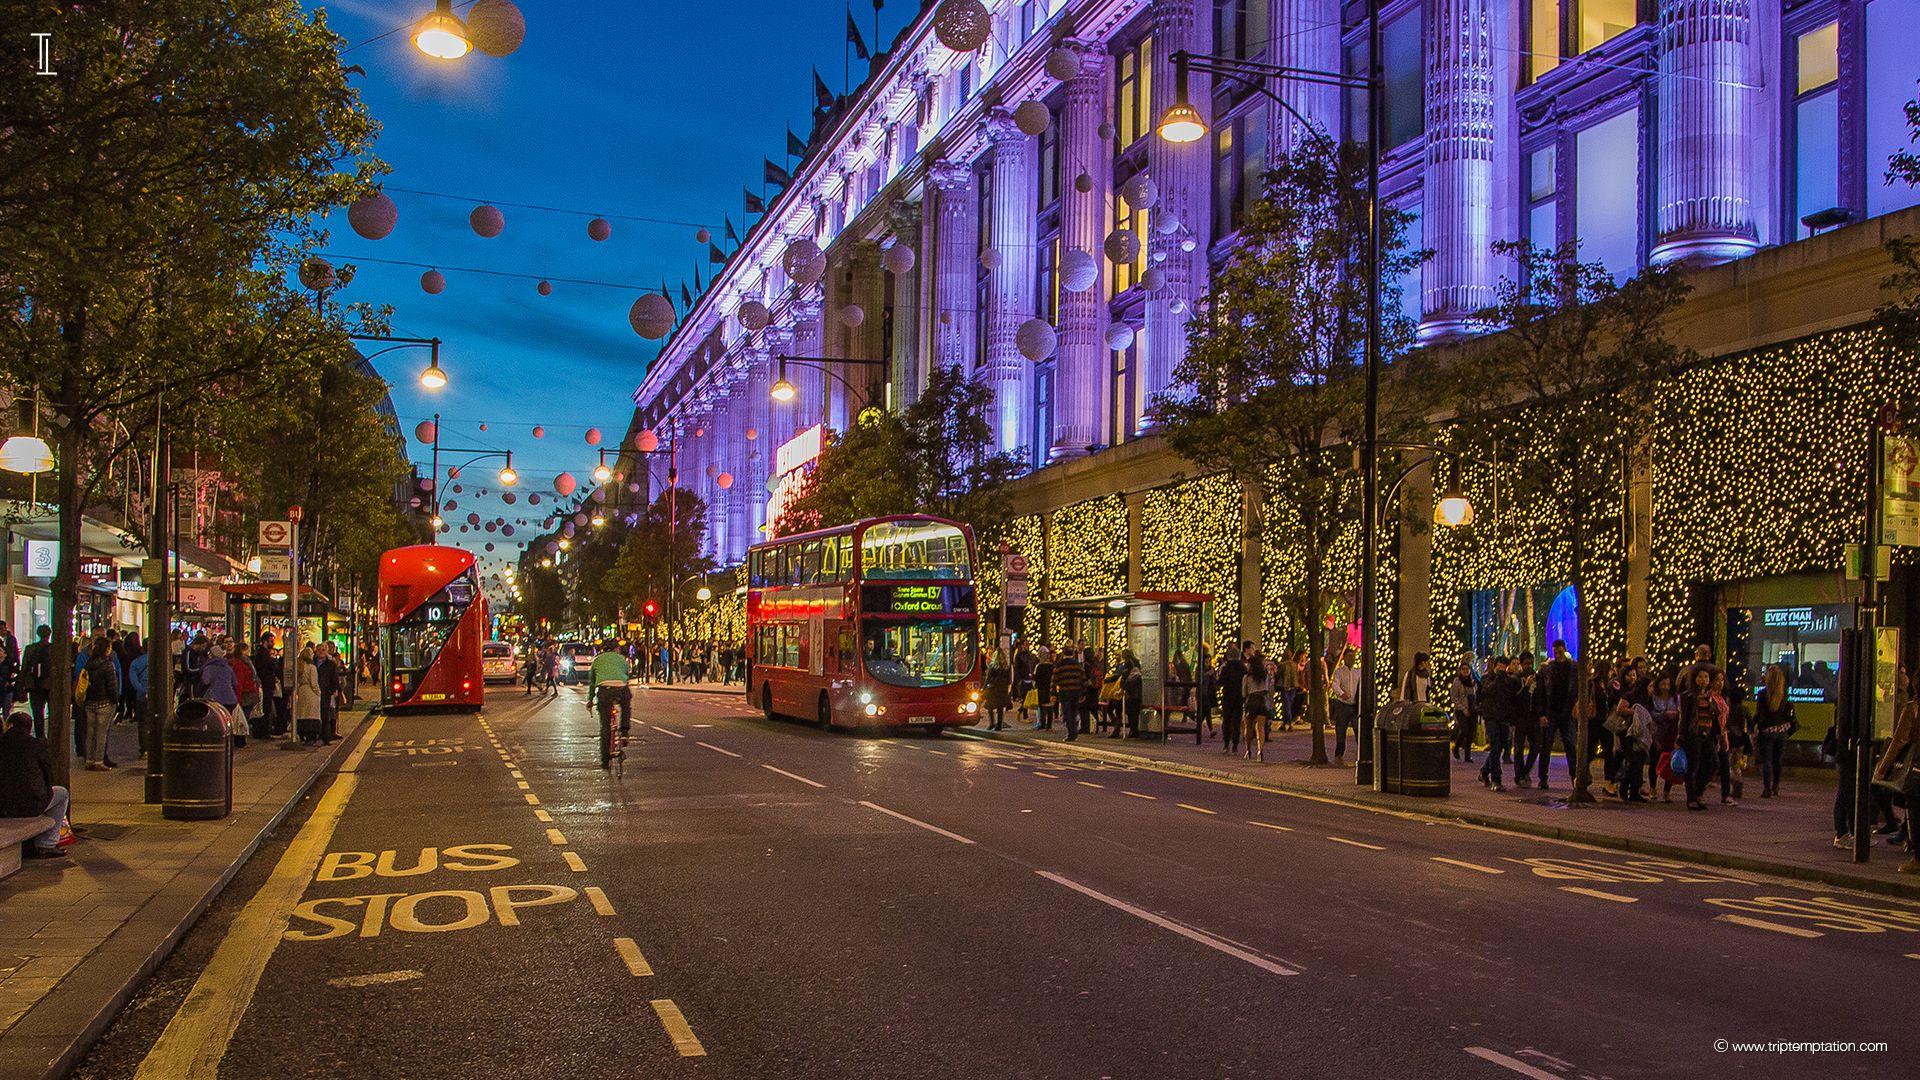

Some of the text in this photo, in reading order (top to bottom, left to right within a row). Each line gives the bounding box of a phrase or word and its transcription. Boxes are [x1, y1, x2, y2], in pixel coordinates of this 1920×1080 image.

[35, 547, 51, 568] 3
[928, 586, 942, 599] 137
[894, 601, 943, 611] Oxford Circus
[428, 607, 441, 621] 10
[1765, 611, 1812, 622] EVERYMAN
[1813, 687, 1825, 696] NOV
[316, 843, 520, 881] BUS
[282, 884, 579, 941] STOP
